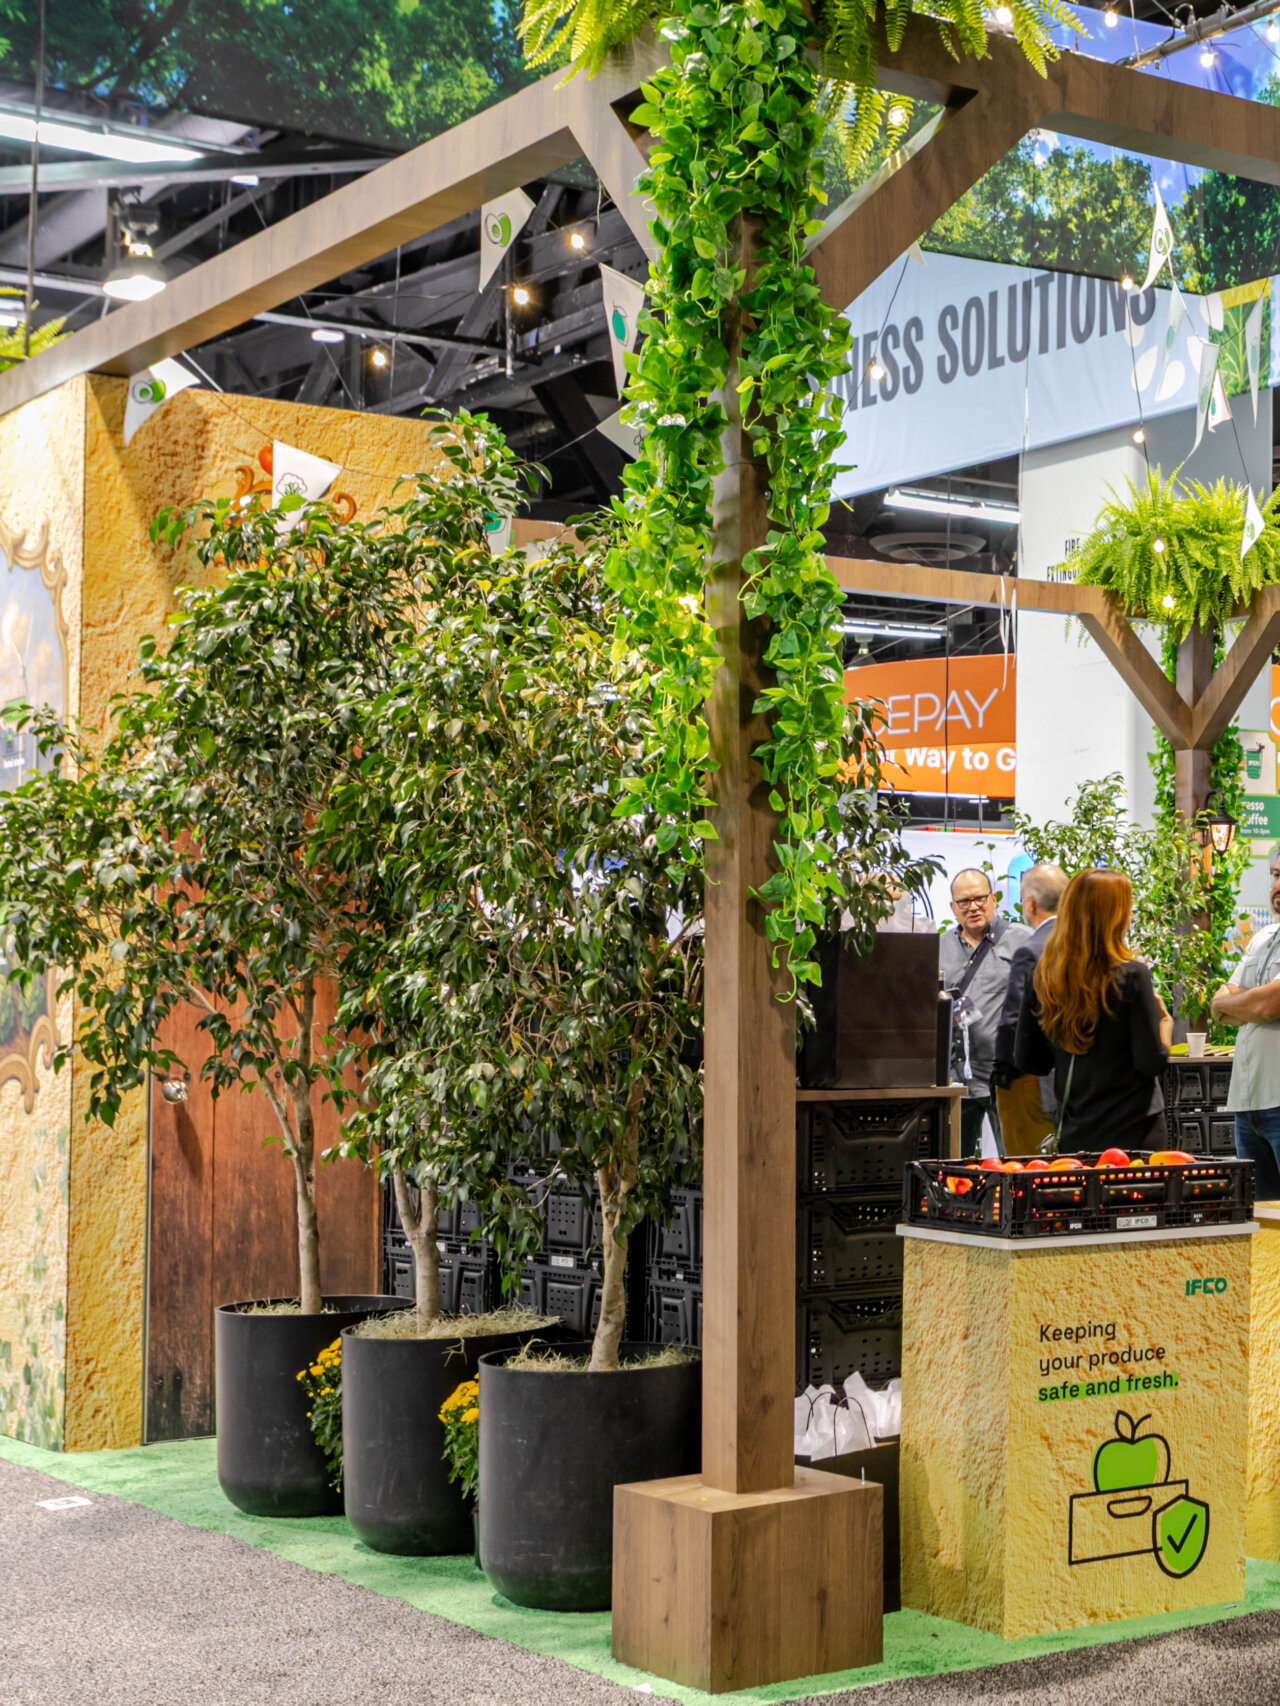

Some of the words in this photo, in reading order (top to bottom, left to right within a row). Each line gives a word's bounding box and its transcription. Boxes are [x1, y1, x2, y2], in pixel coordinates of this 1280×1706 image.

[936, 271, 1157, 385] SOLUTIONS
[905, 746, 956, 775] Way
[961, 747, 990, 771] to
[1185, 1277, 1228, 1296] IFCO
[1039, 1320, 1117, 1344] Keeping
[1039, 1354, 1083, 1377] your
[1088, 1345, 1166, 1371] produce
[1038, 1381, 1080, 1402] safe
[1085, 1376, 1120, 1397] and
[1126, 1370, 1179, 1391] fresh.
